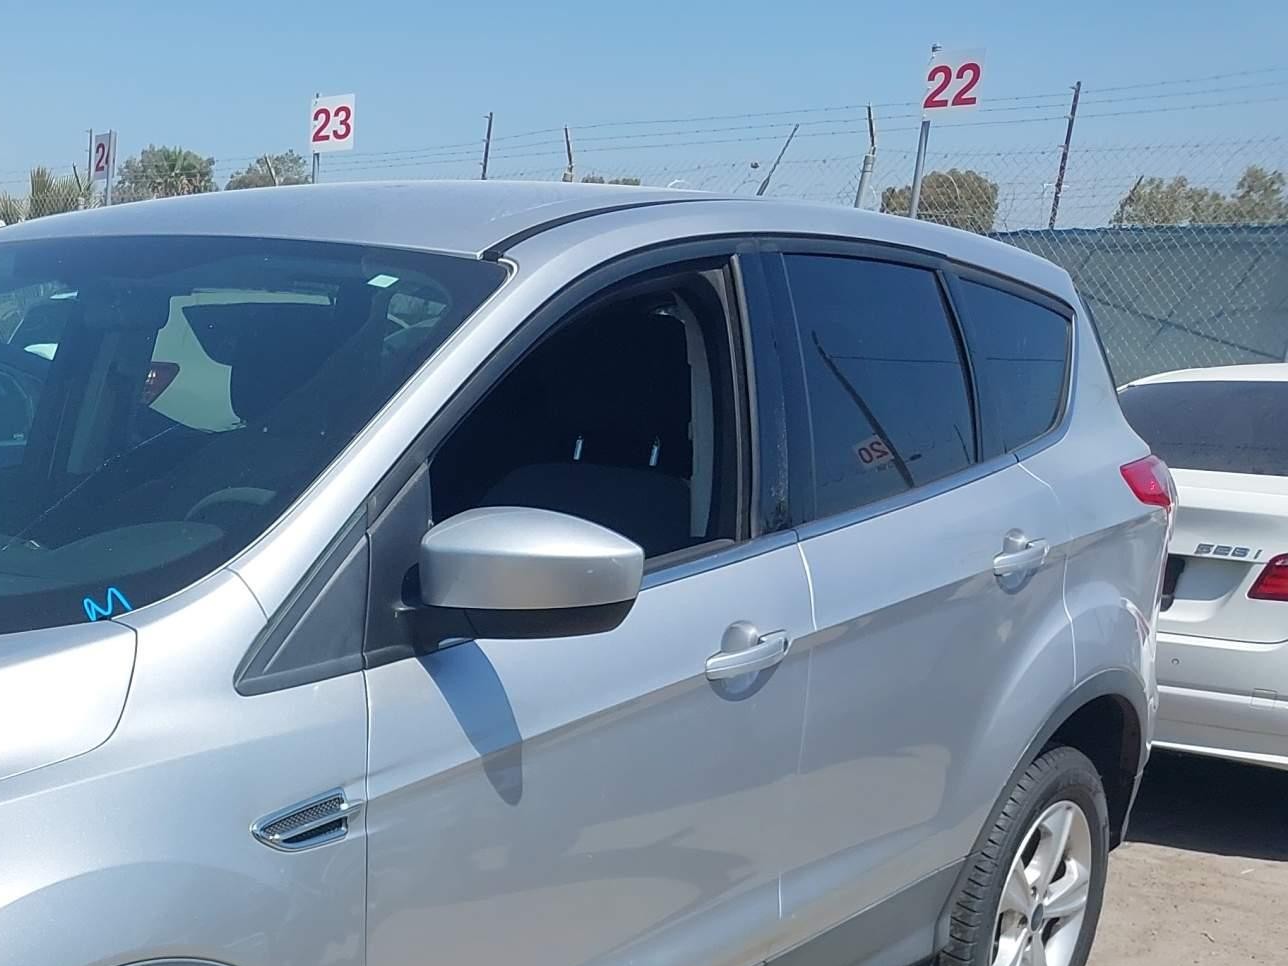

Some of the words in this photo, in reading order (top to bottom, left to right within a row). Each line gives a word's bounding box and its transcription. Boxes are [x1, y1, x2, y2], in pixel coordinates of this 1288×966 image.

[923, 62, 981, 108] 22
[312, 105, 352, 142] 23
[83, 587, 132, 621] M
